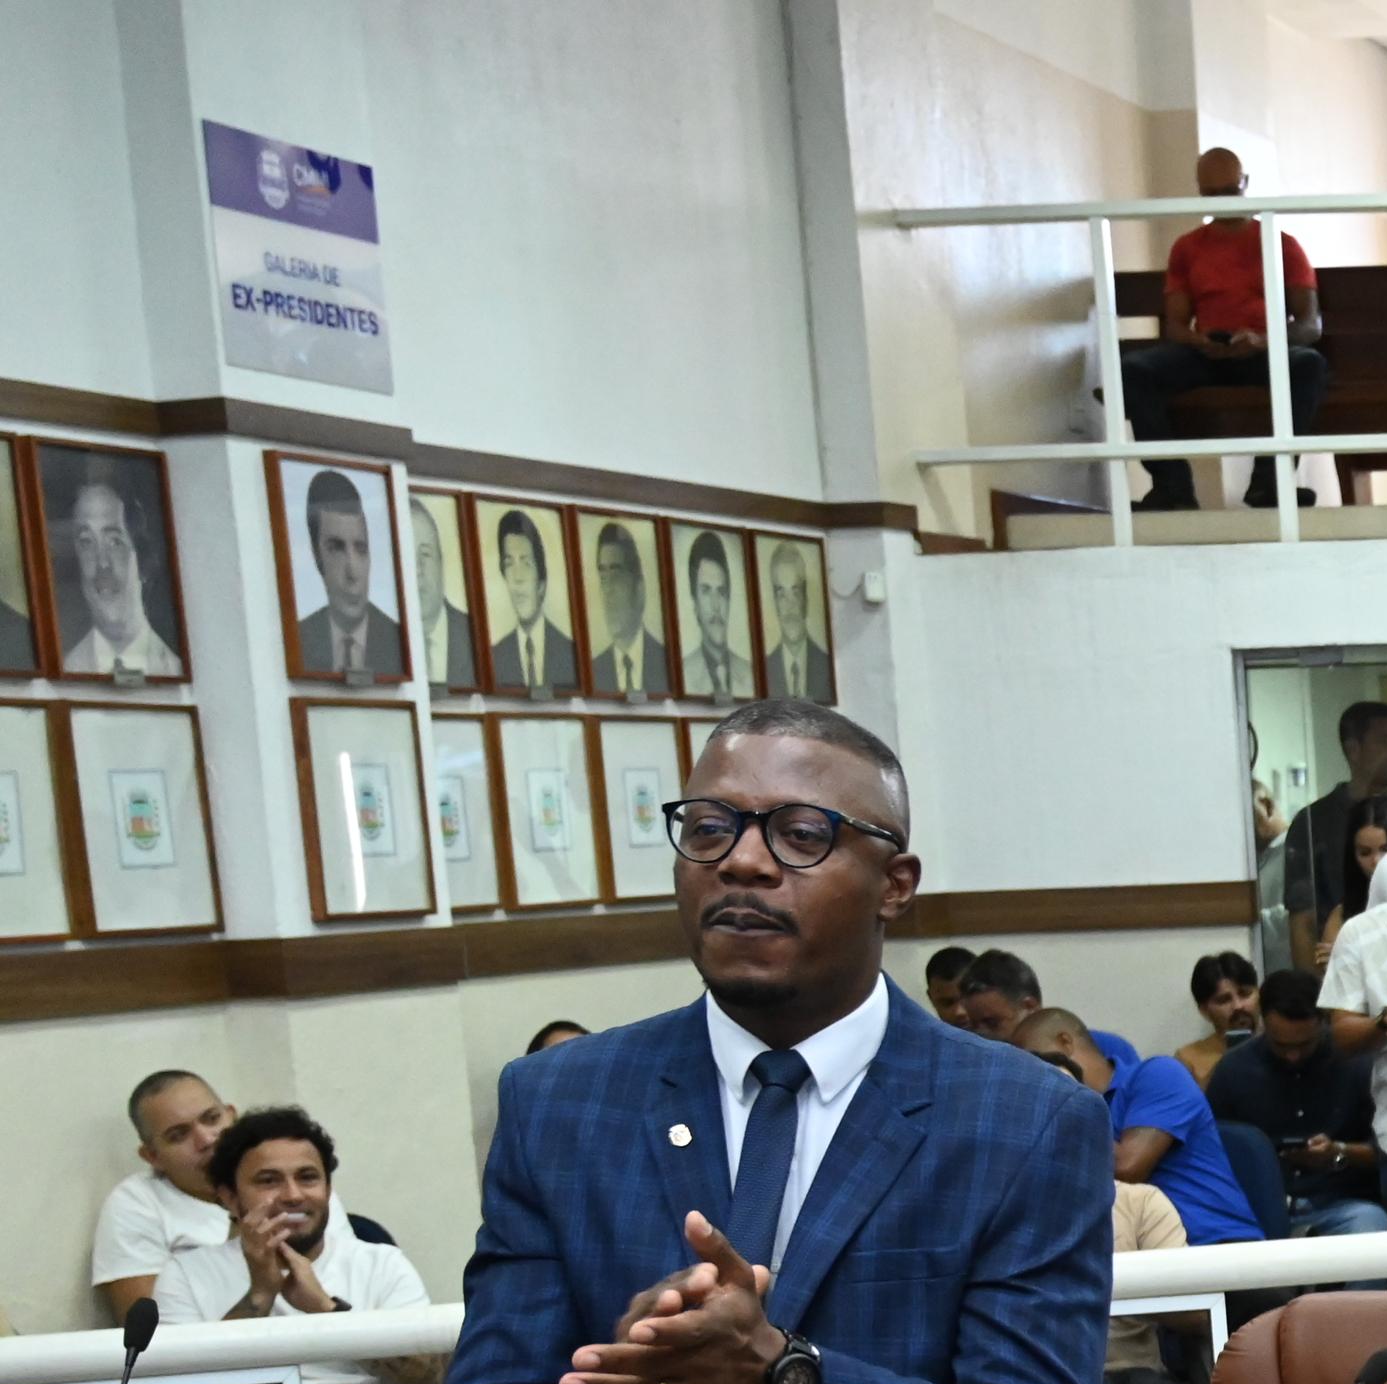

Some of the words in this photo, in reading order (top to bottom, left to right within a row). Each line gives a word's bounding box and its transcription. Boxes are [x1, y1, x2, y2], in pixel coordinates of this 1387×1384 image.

[263, 251, 319, 279] GALERIA
[322, 264, 341, 287] DE
[230, 282, 379, 336] EX-PRESIDENTES
